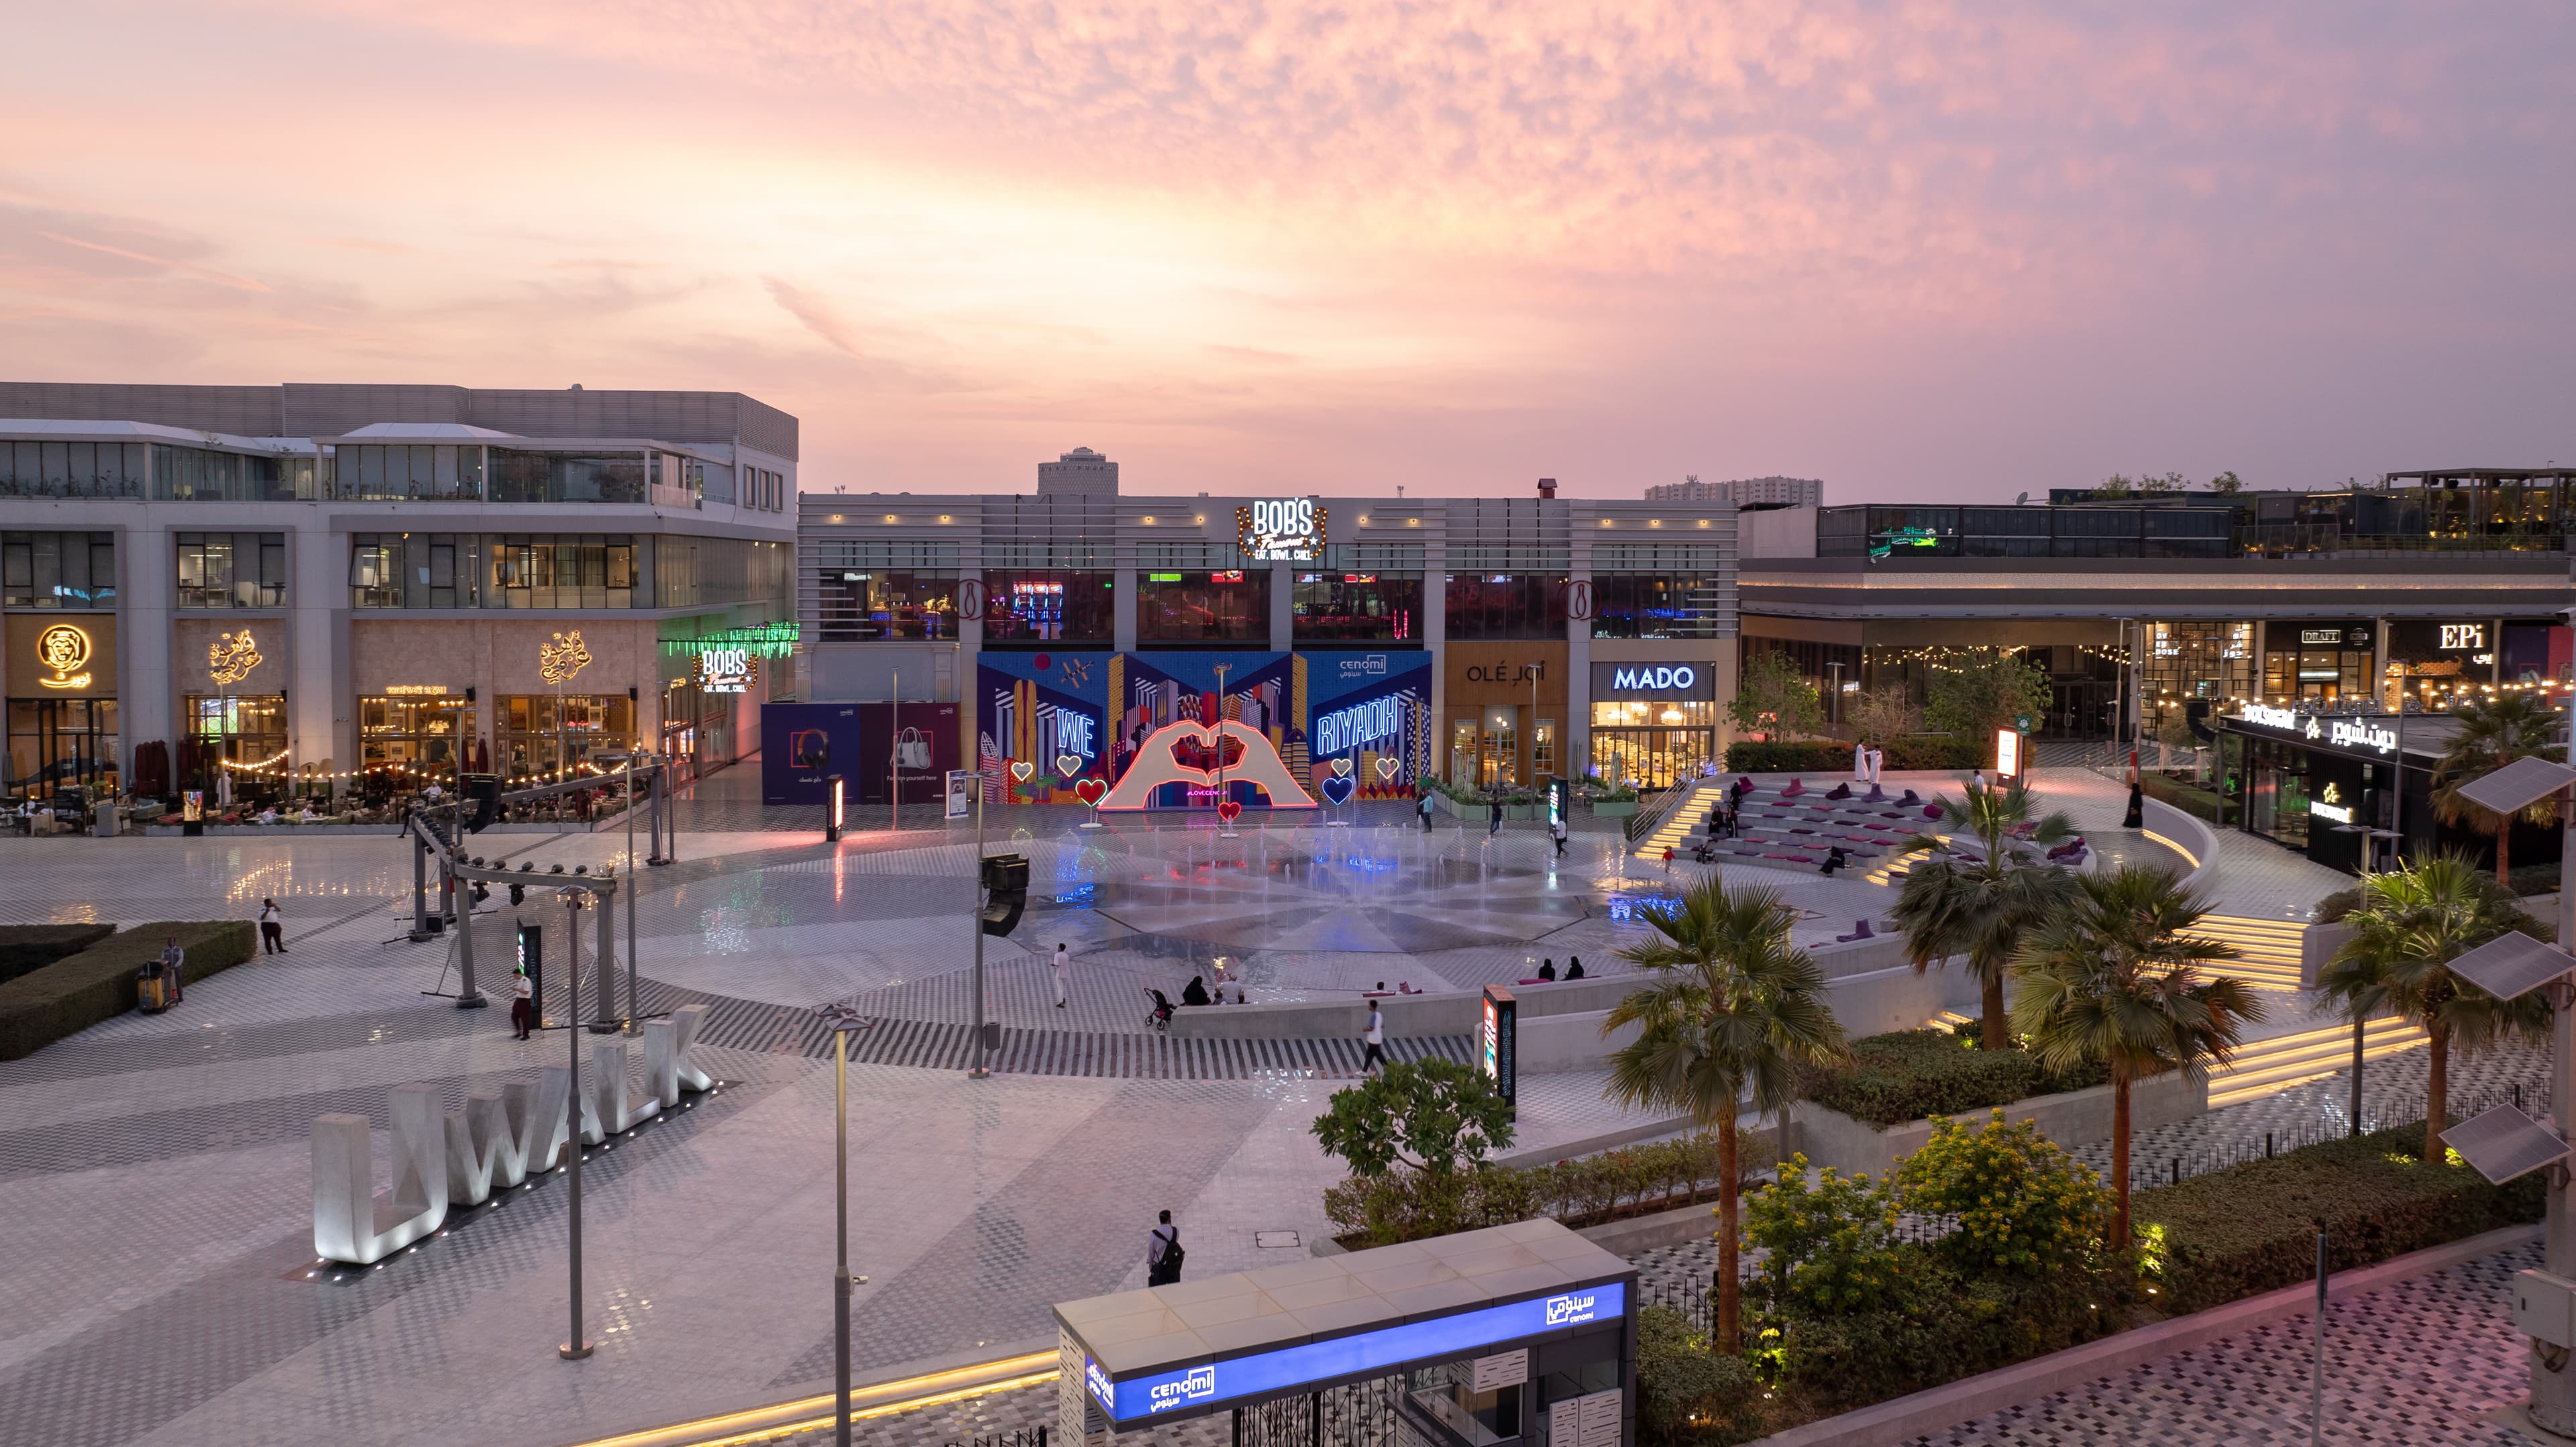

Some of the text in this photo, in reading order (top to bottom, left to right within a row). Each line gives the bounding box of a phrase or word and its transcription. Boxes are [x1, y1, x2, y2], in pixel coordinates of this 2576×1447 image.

[1254, 497, 1313, 535] BOB'S
[2305, 632, 2338, 641] DRAFT
[1467, 660, 1508, 682] OLÉ
[1614, 666, 1695, 690] MADO
[1057, 708, 1094, 758] WE
[1318, 696, 1398, 755] RIYADH
[1150, 1371, 1213, 1399] cenomi
